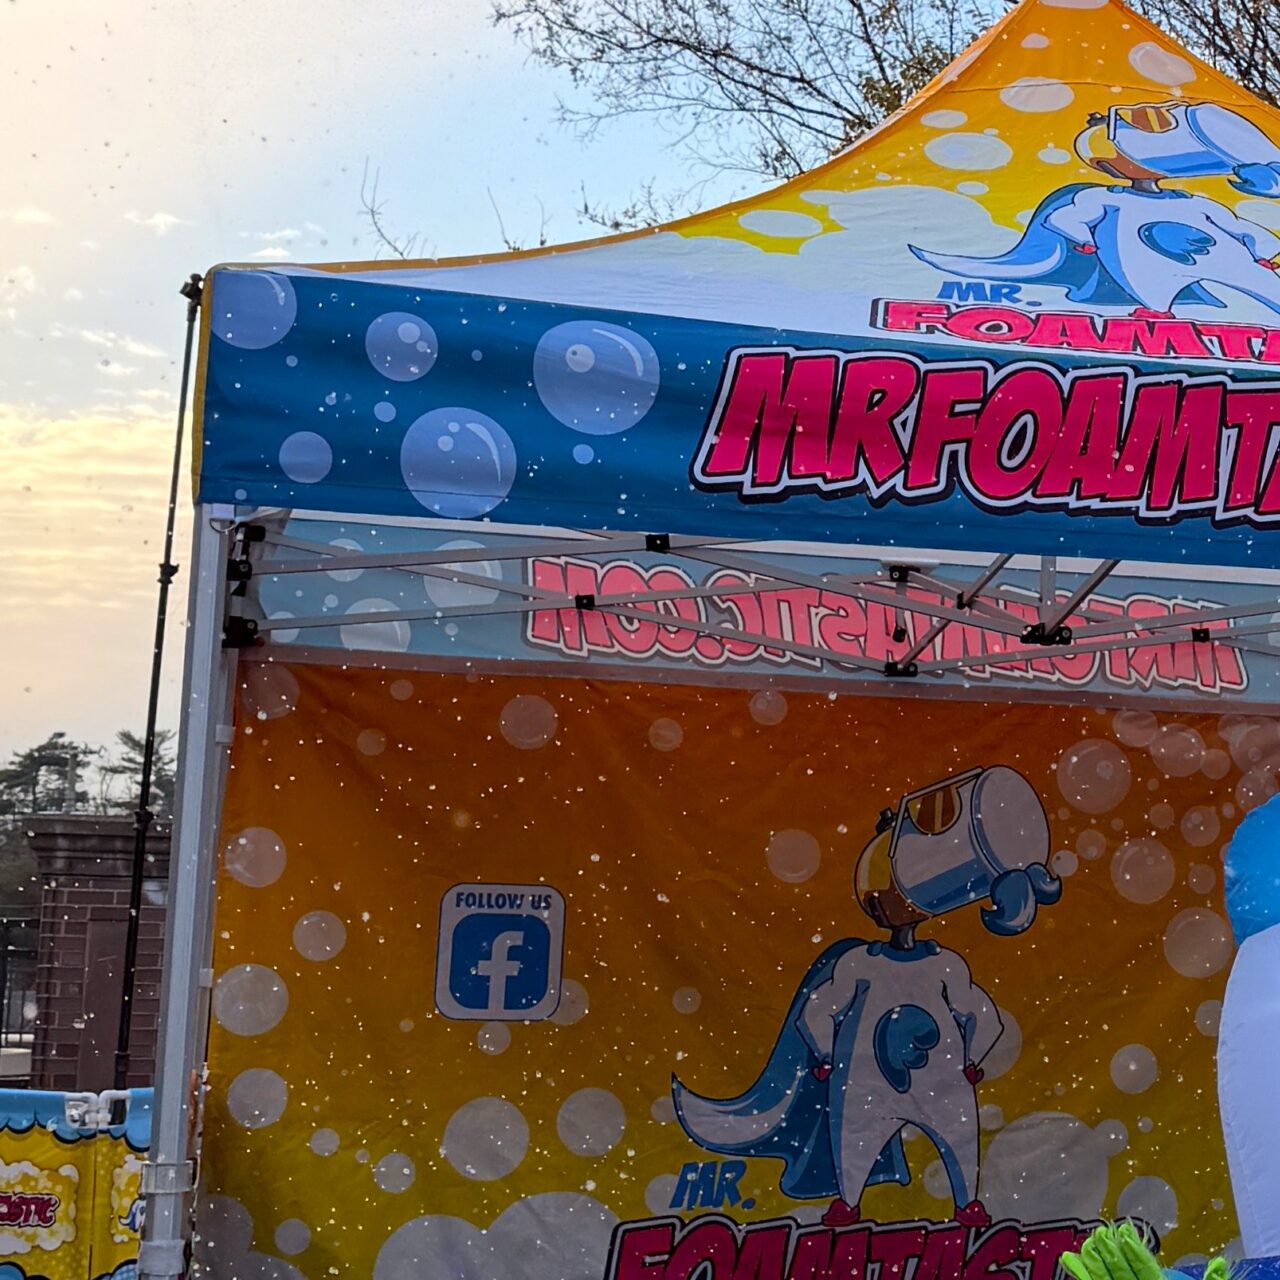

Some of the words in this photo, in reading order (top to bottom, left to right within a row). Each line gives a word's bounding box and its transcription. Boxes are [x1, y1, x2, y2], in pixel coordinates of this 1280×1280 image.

[937, 281, 1042, 307] MR.
[455, 892, 525, 910] FOLLOW
[531, 894, 552, 910] US
[669, 1160, 757, 1211] MR.
